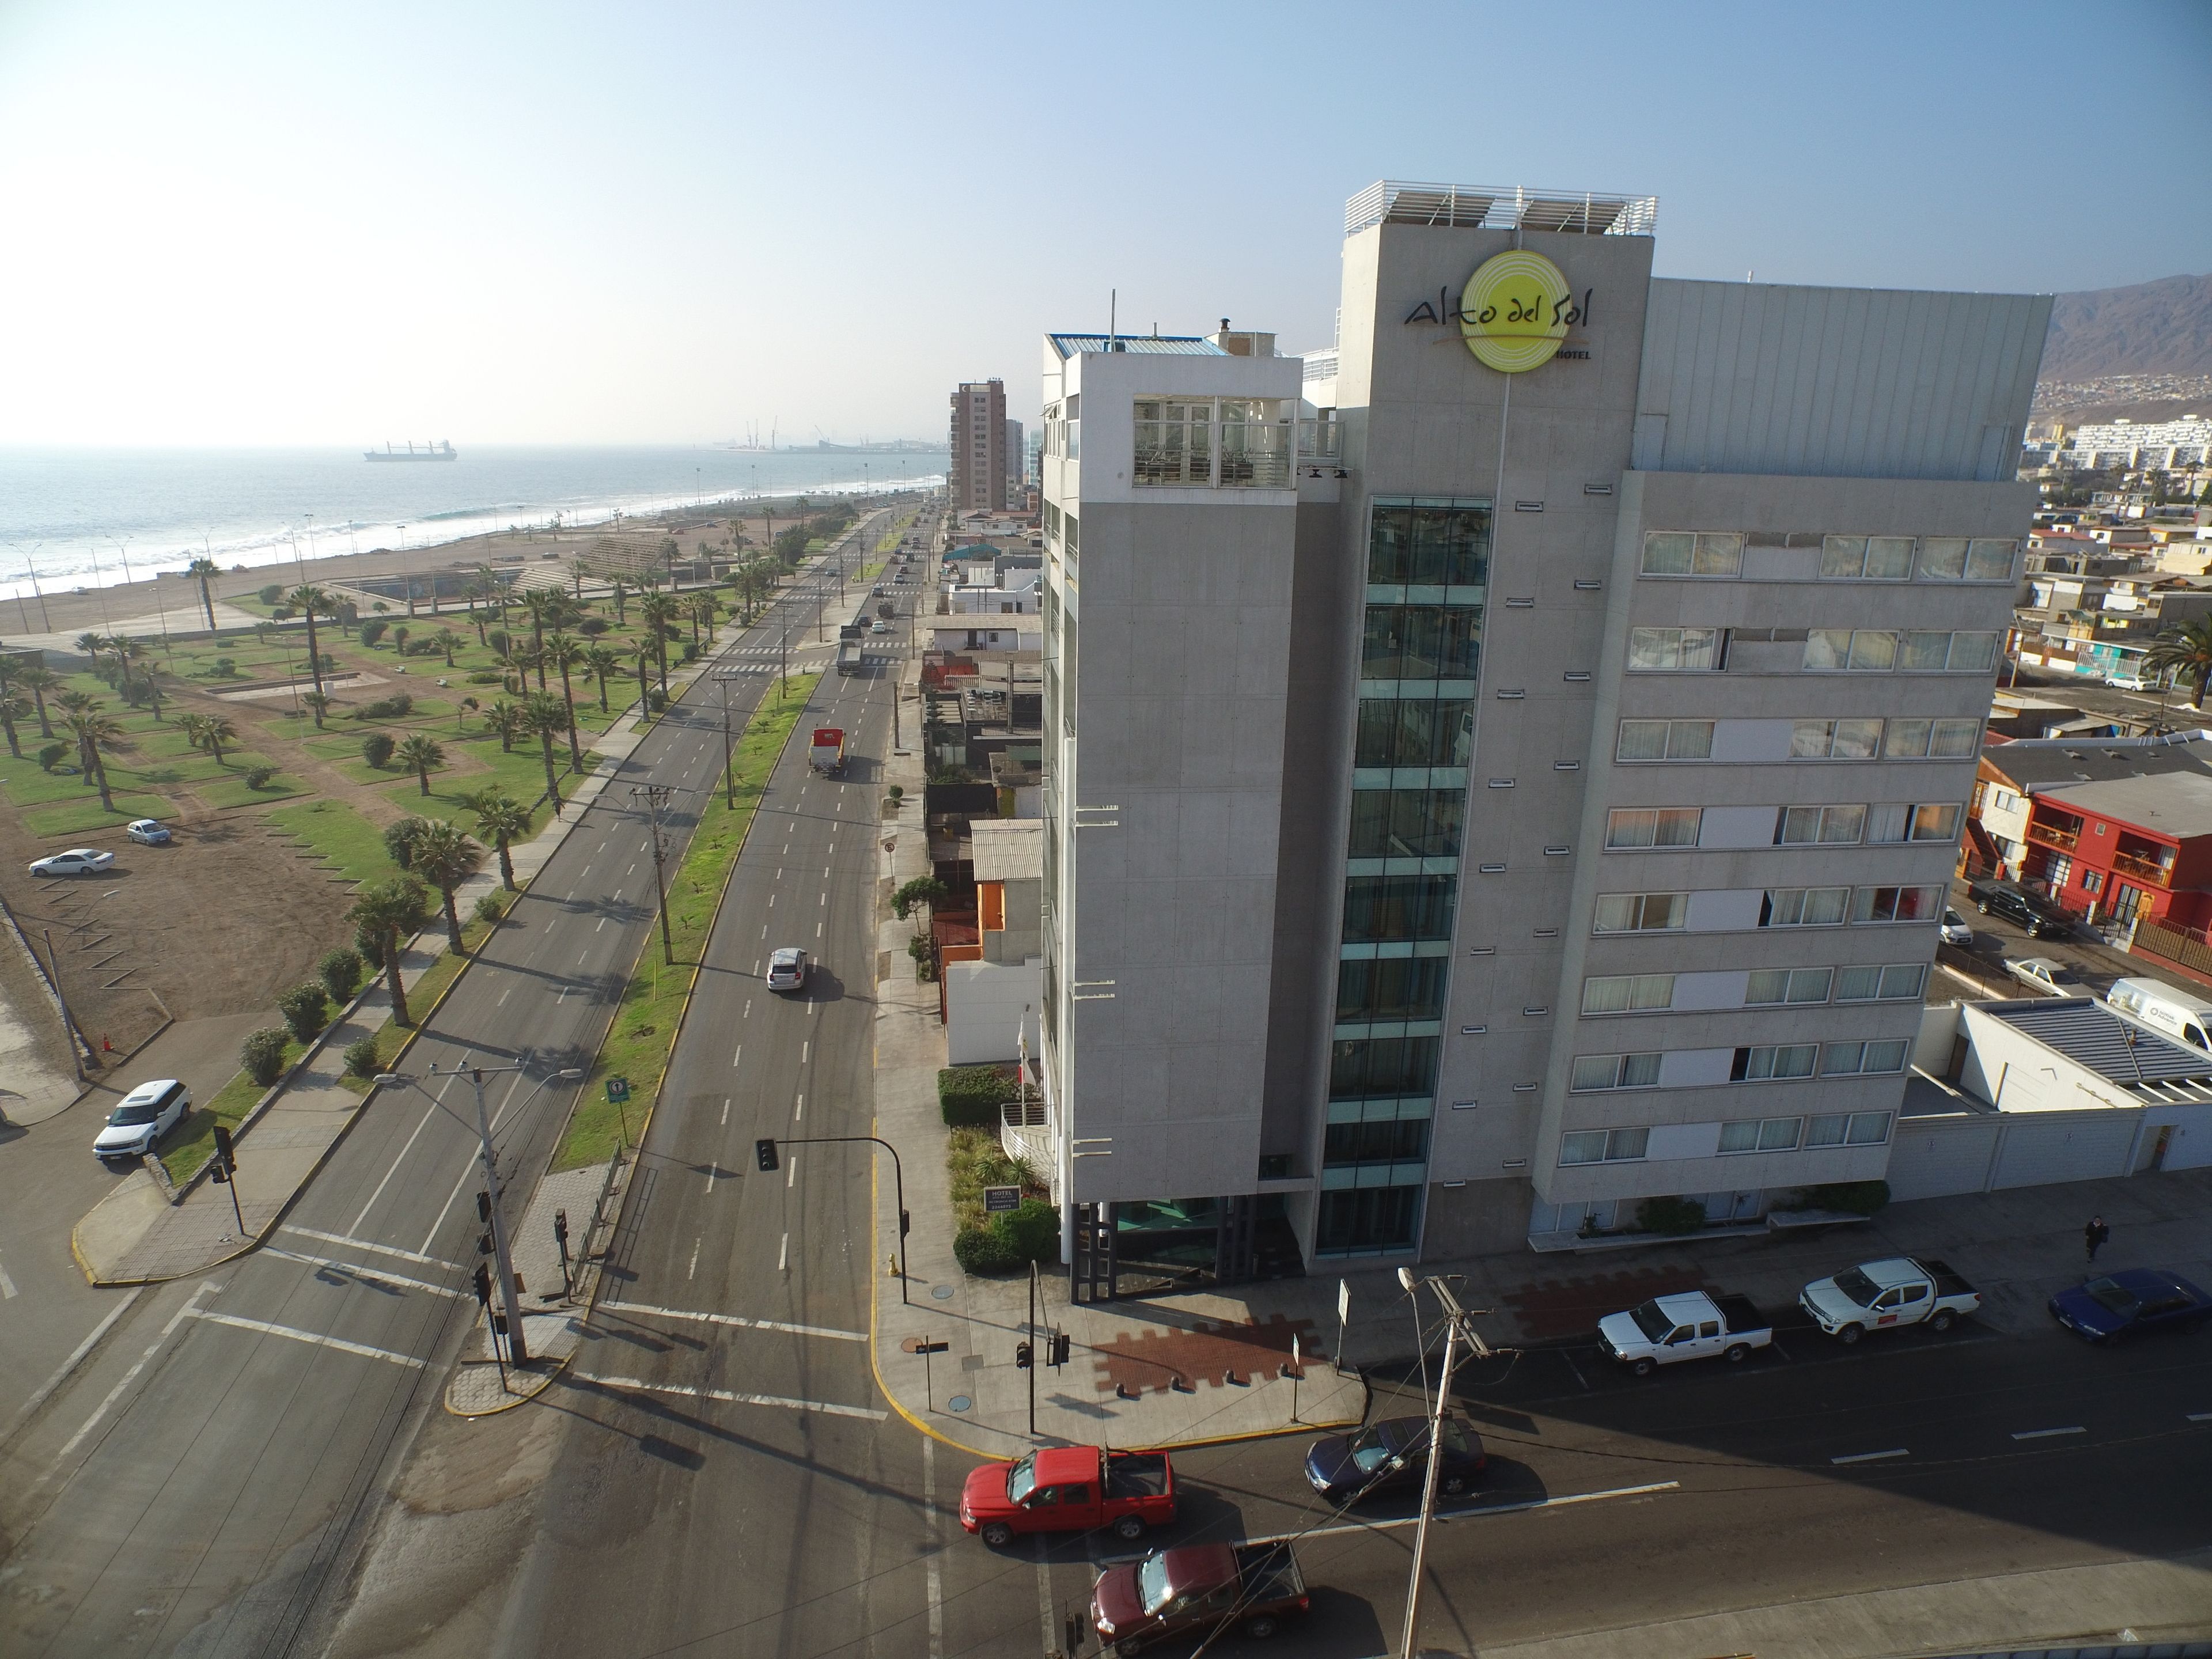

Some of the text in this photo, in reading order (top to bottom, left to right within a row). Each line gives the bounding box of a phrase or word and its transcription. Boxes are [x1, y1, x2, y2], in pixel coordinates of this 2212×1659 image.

[1404, 286, 1593, 327] Alto del Sol
[1556, 350, 1592, 360] HOTEL
